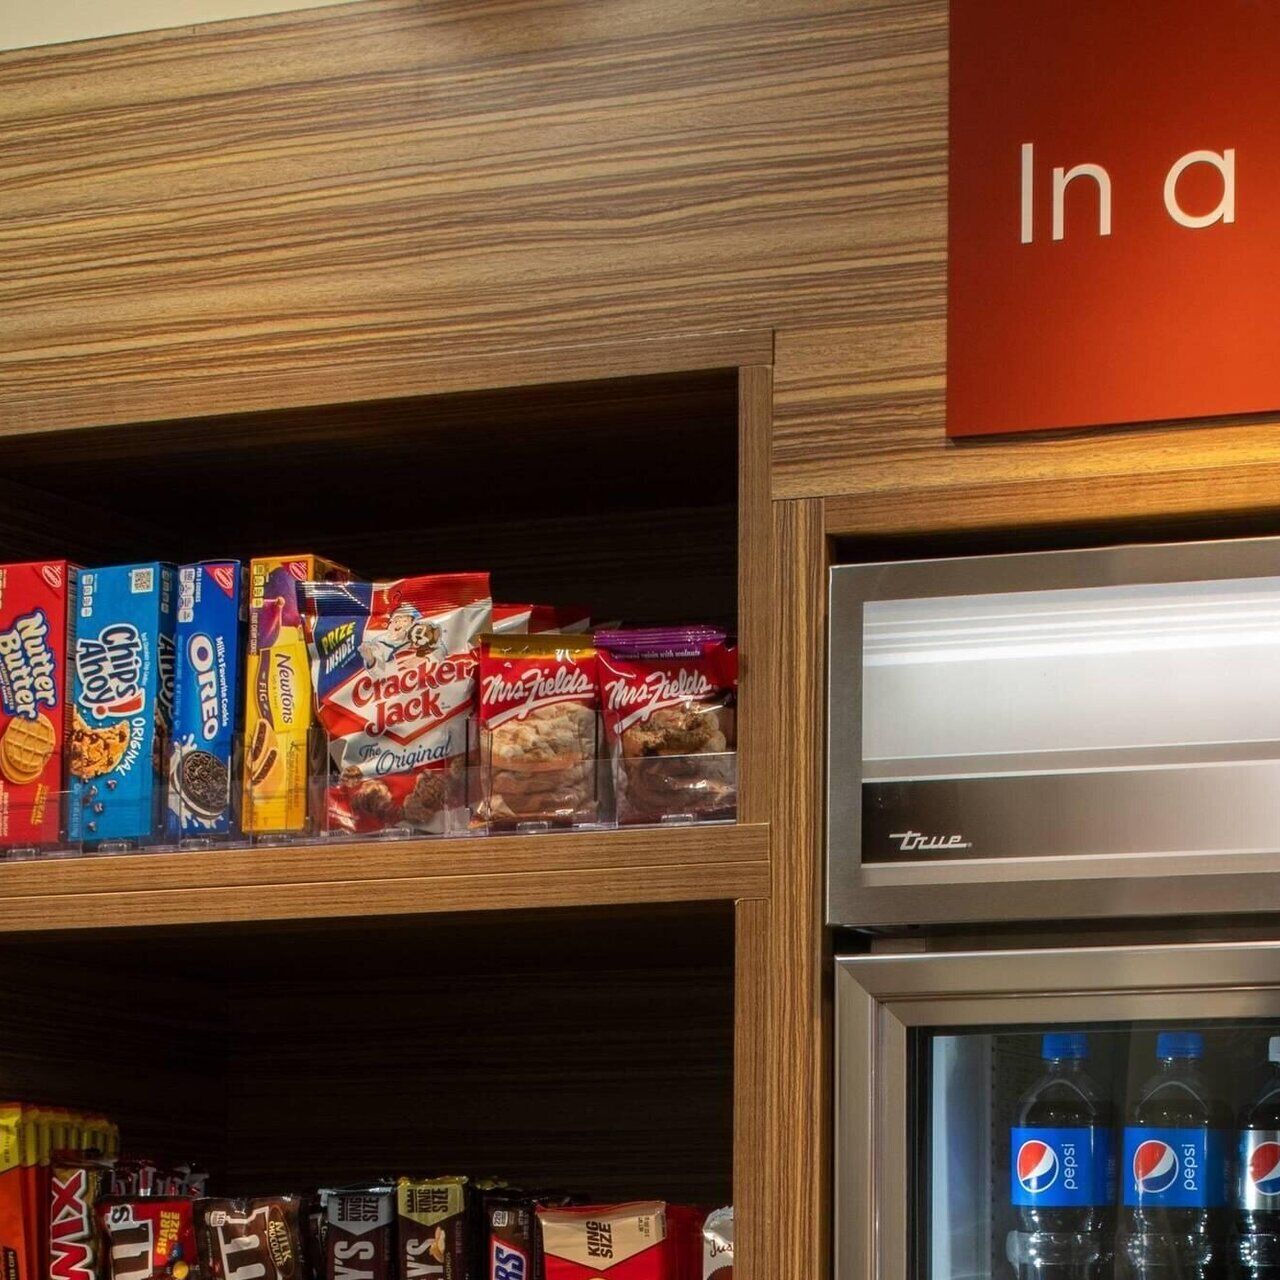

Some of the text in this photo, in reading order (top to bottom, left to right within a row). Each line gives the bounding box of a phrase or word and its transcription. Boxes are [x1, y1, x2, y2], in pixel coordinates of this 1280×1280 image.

[1019, 142, 1113, 244] In
[1163, 148, 1236, 230] a
[16, 610, 55, 708] Nutter
[322, 622, 356, 653] PRIZE
[100, 626, 140, 698] Chips
[352, 658, 473, 707] Cracker
[189, 633, 220, 741] OREO
[219, 662, 229, 727] Favorite Cookie
[259, 681, 267, 703] FIG
[277, 653, 295, 724] Newtons
[366, 691, 442, 736] Jack
[117, 718, 145, 776] ORIGINAL
[359, 735, 450, 773] The Original
[1063, 1142, 1079, 1191] pepsi
[1183, 1142, 1199, 1192] pepsi
[348, 1196, 363, 1222] KING
[363, 1196, 379, 1222] SIZE
[417, 1189, 432, 1213] KING
[432, 1188, 449, 1213] SIZE
[157, 1210, 171, 1255] SHARE
[168, 1211, 180, 1241] SIZE
[269, 1220, 283, 1266] CHOCOLATE
[274, 1221, 292, 1261] MILK
[586, 1221, 600, 1257] KING
[599, 1222, 613, 1258] SIZE
